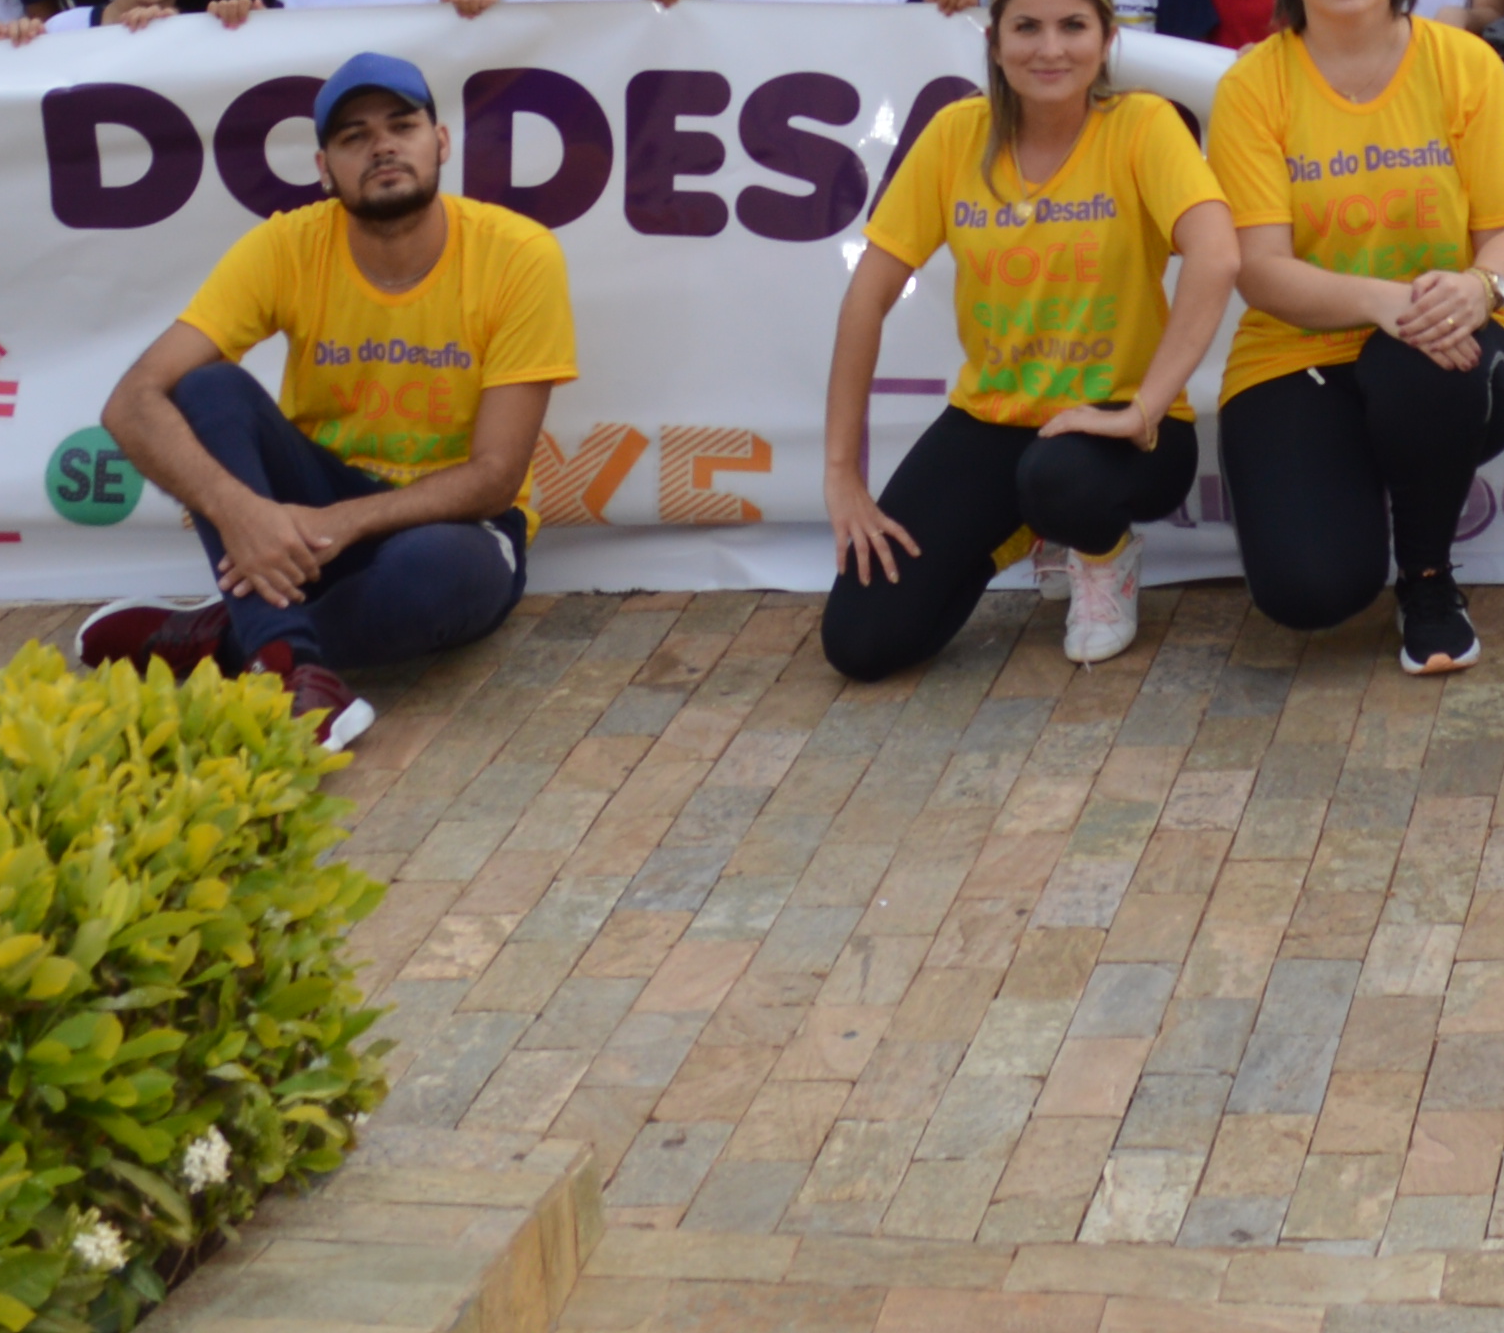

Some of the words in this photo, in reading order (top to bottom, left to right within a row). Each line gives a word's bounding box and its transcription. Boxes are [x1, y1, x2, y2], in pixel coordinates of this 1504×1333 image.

[41, 75, 334, 231] DO
[1329, 150, 1359, 177] do
[1364, 139, 1454, 171] Desafio
[954, 199, 988, 228] Dia
[1035, 192, 1118, 225] Desafio
[1301, 175, 1442, 238] VOCÊ
[965, 229, 1102, 288] VOCÊ
[314, 340, 351, 367] Dia
[358, 338, 386, 363] do
[388, 338, 472, 370] Desafio
[58, 447, 129, 504] SE
